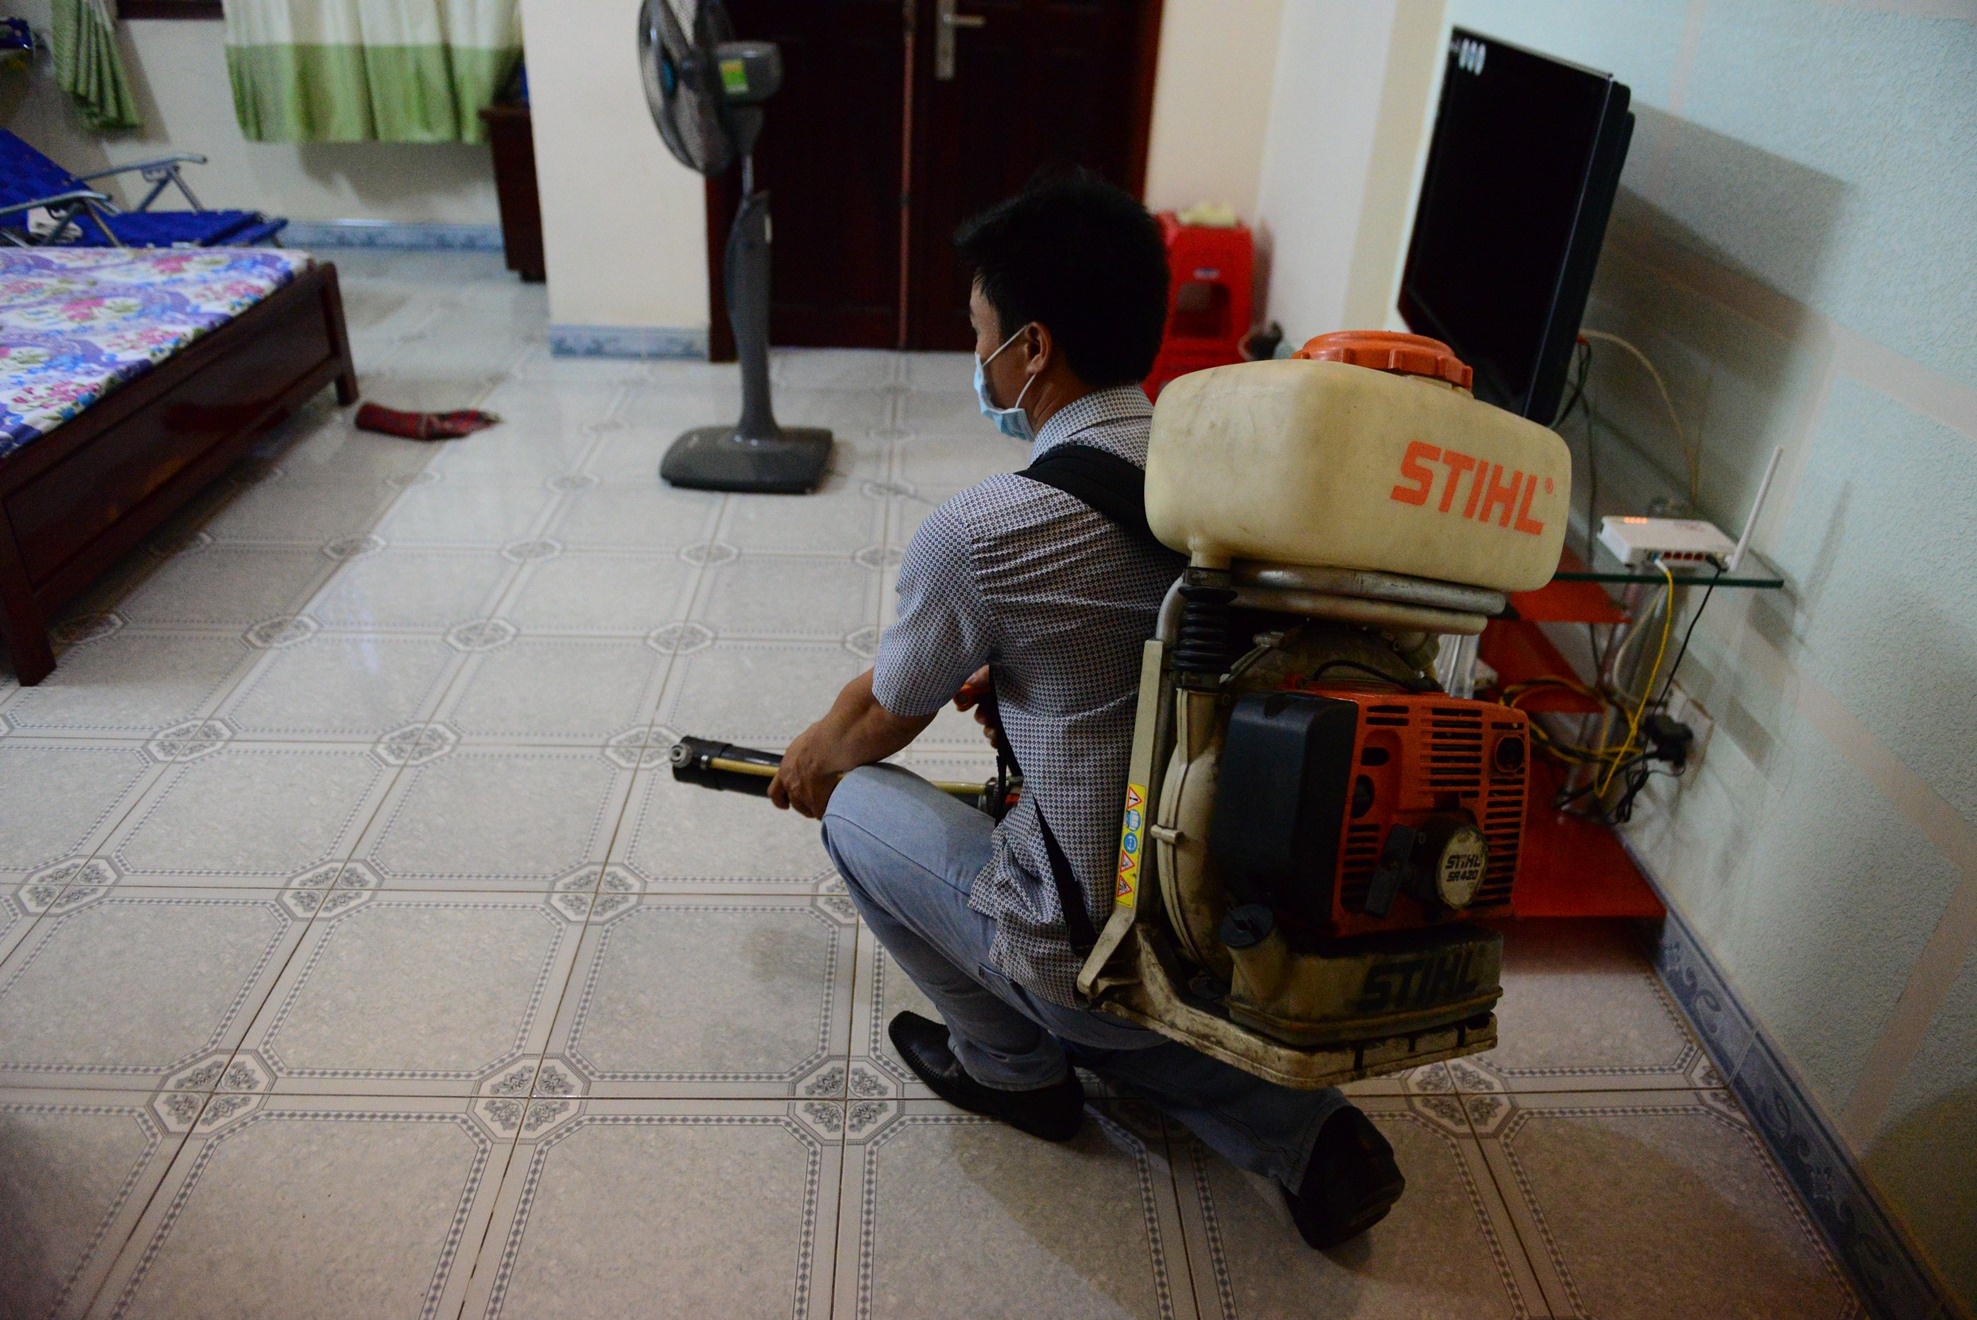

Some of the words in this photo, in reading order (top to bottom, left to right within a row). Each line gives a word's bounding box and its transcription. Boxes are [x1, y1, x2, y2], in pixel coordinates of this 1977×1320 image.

[1390, 440, 1544, 535] STIHL
[1445, 854, 1481, 869] STIHL
[1357, 950, 1478, 1012] STIHL
